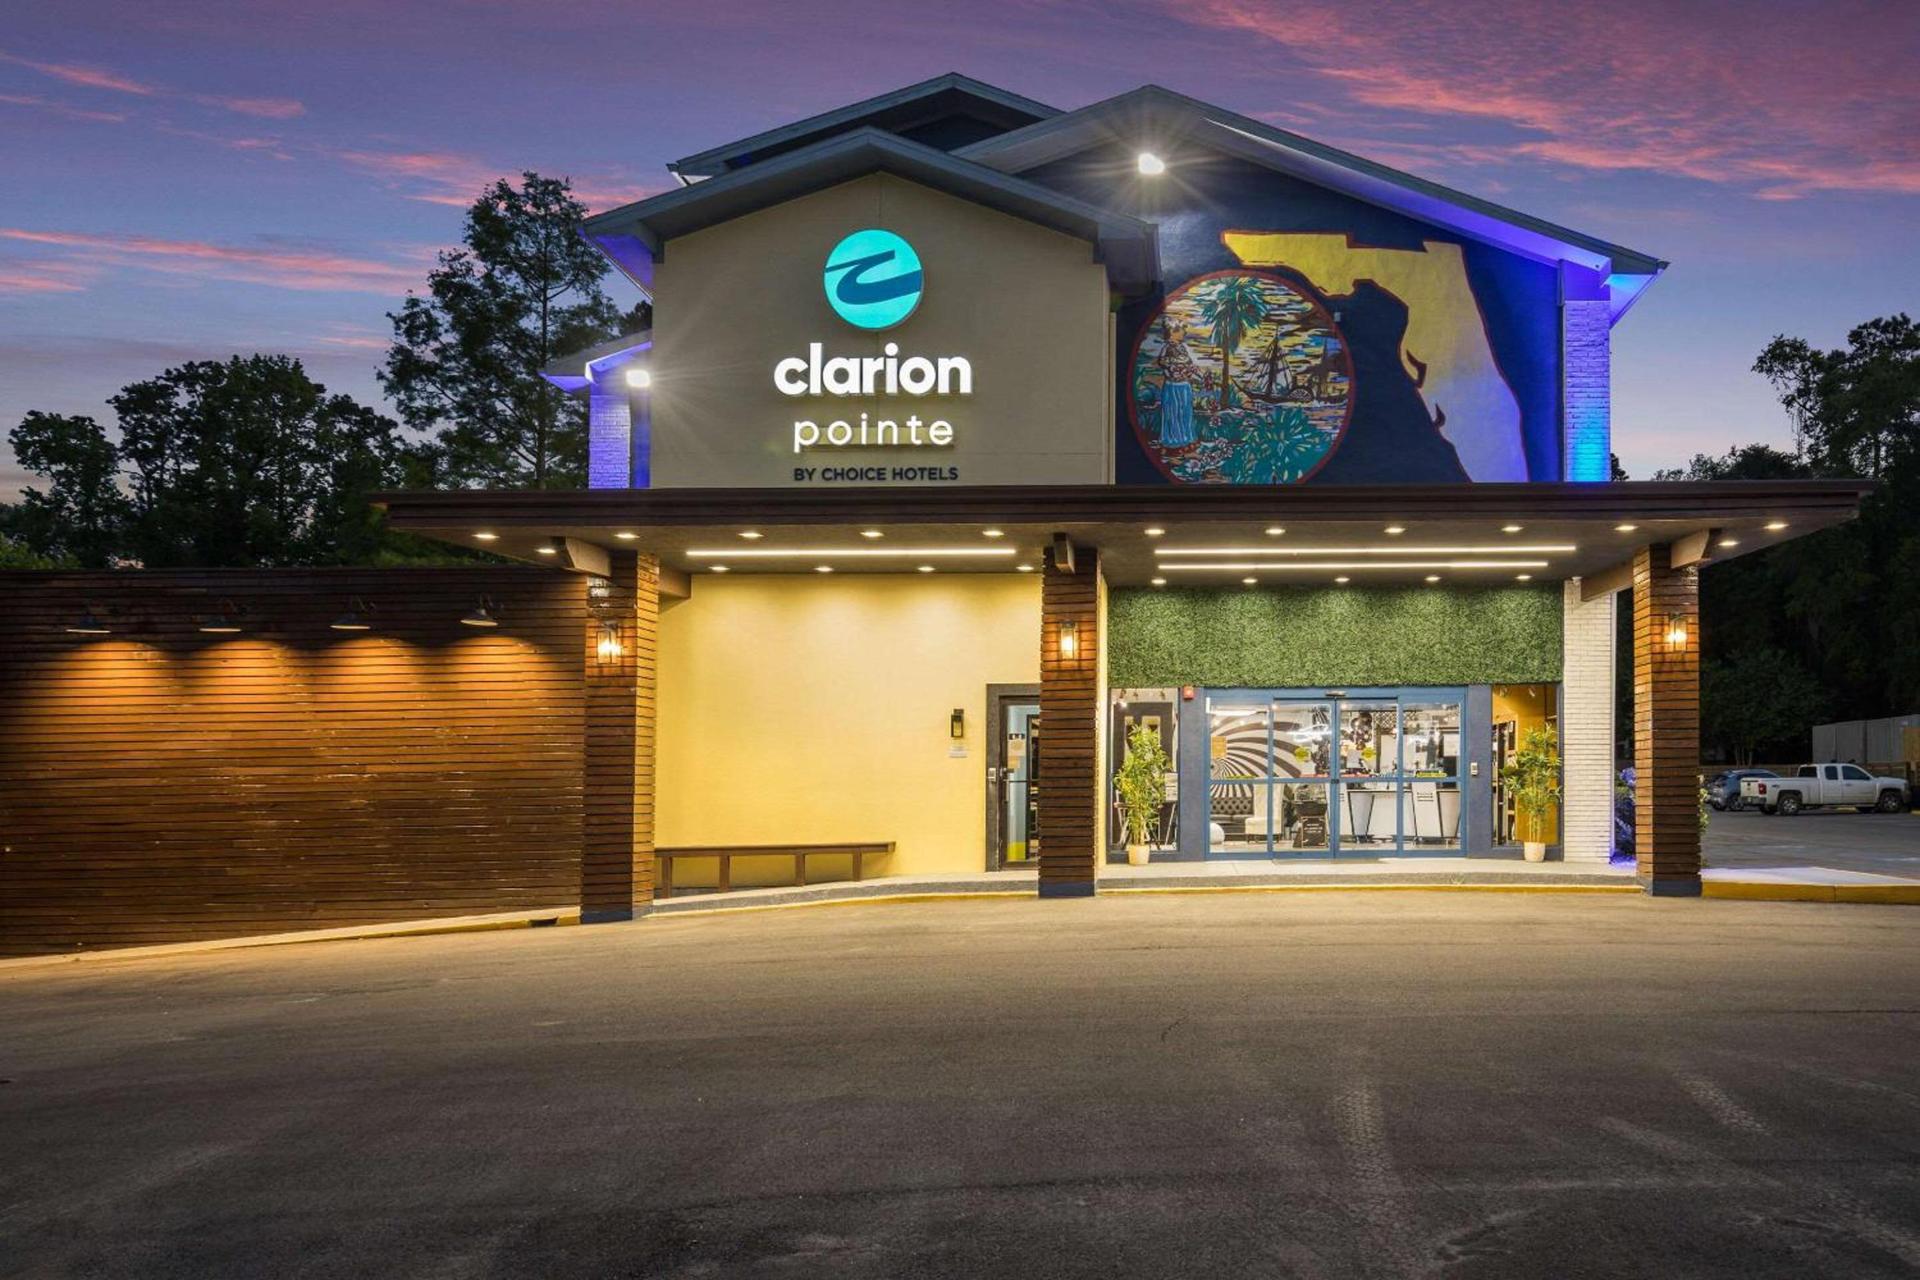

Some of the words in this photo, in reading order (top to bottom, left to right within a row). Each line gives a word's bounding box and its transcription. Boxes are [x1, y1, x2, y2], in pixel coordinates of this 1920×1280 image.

[774, 342, 972, 395] clarion
[794, 413, 954, 453] pointe
[794, 468, 816, 482] BY
[821, 467, 887, 481] CHOICE
[892, 466, 959, 481] HOTELS
